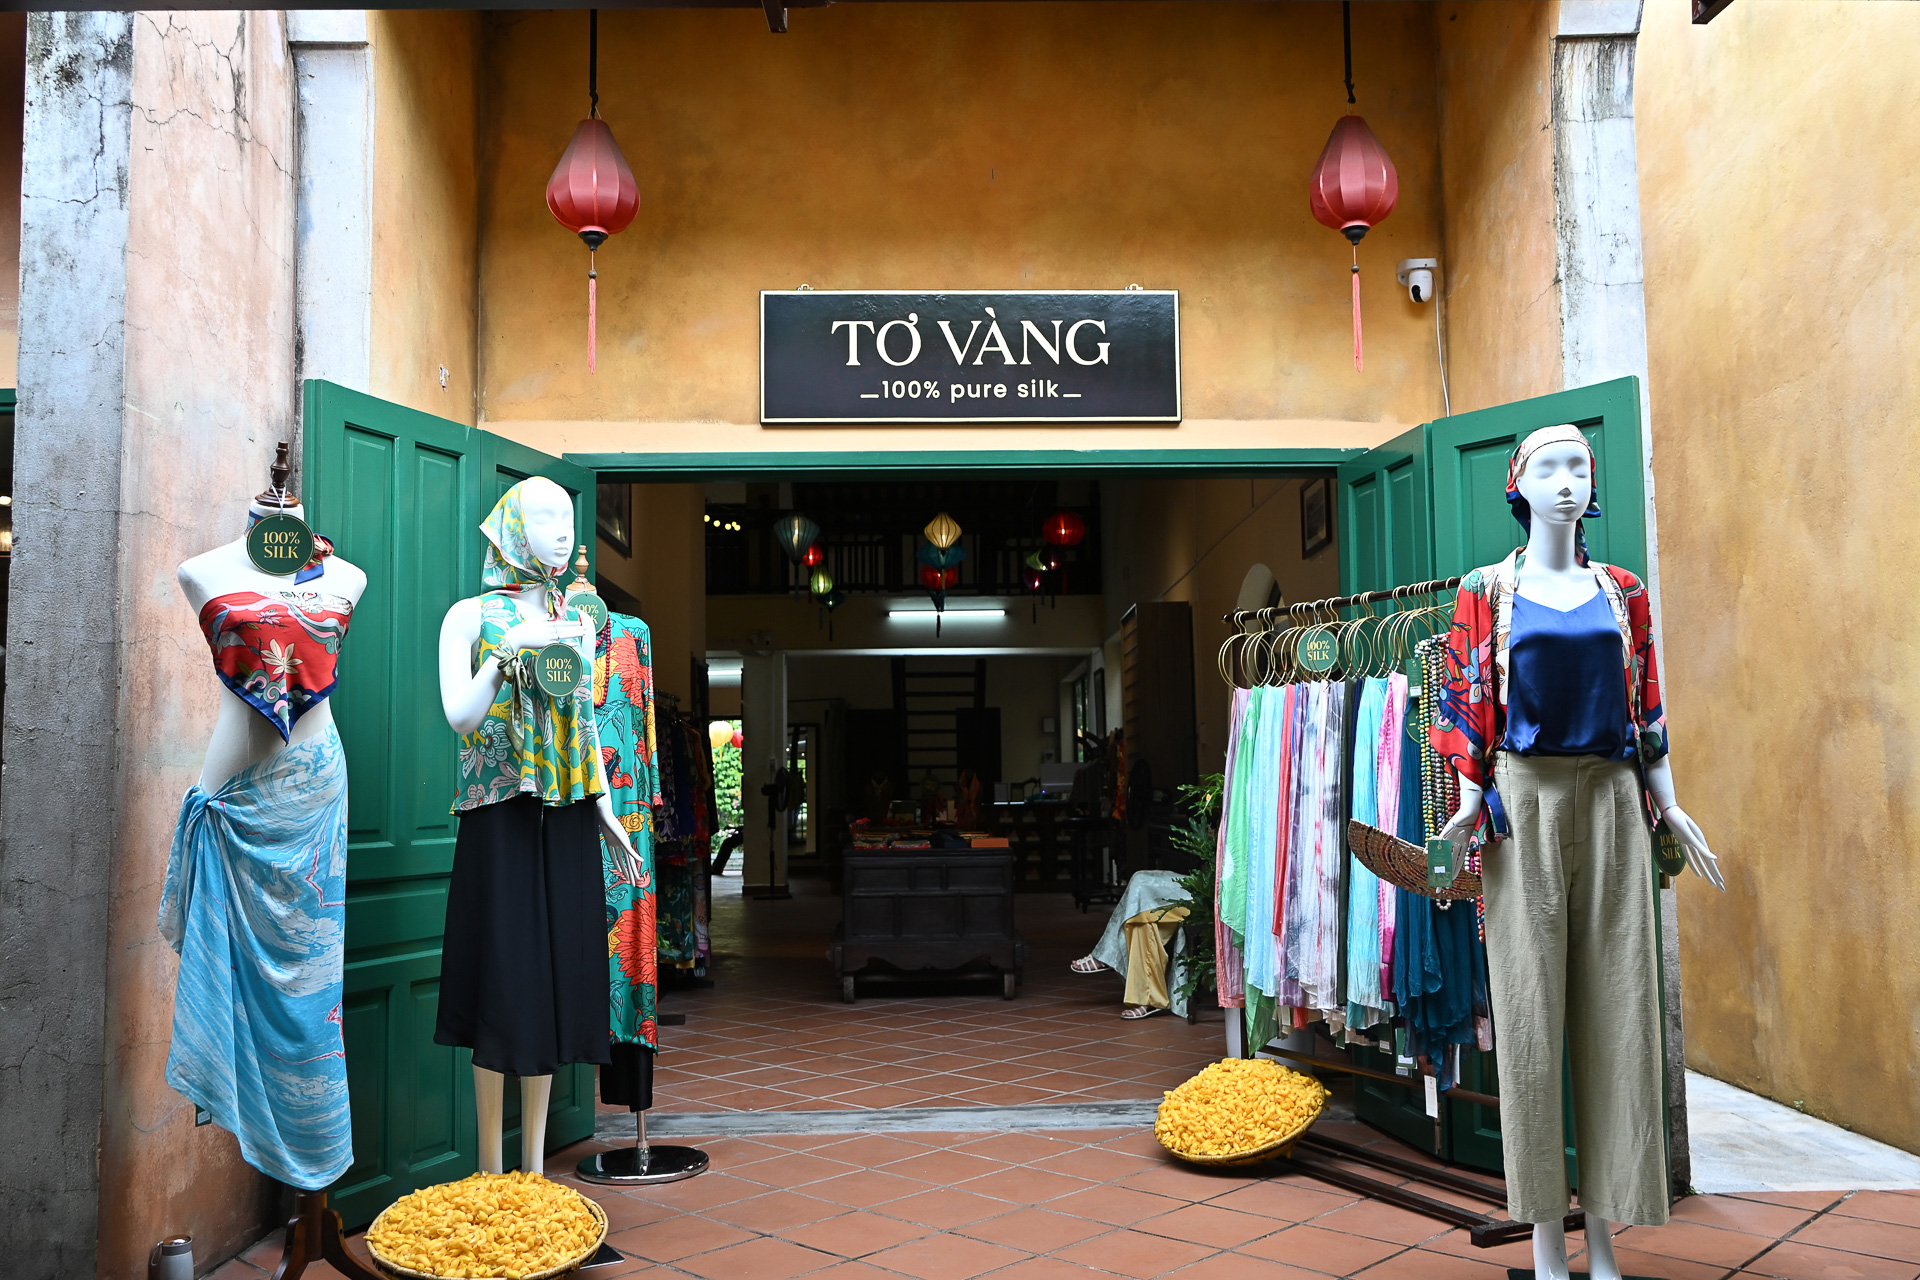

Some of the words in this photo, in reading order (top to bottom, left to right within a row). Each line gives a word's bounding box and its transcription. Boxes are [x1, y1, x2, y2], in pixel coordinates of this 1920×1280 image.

[831, 312, 922, 366] TƠ
[937, 307, 1111, 366] VÀNG
[951, 381, 1007, 403] pure
[1017, 379, 1059, 399] silk
[263, 531, 300, 545] 100%
[264, 545, 299, 559] SILK
[1307, 650, 1330, 660] SILK
[545, 658, 573, 670] 100%
[546, 670, 572, 683] SILK
[1661, 847, 1681, 860] SILK
